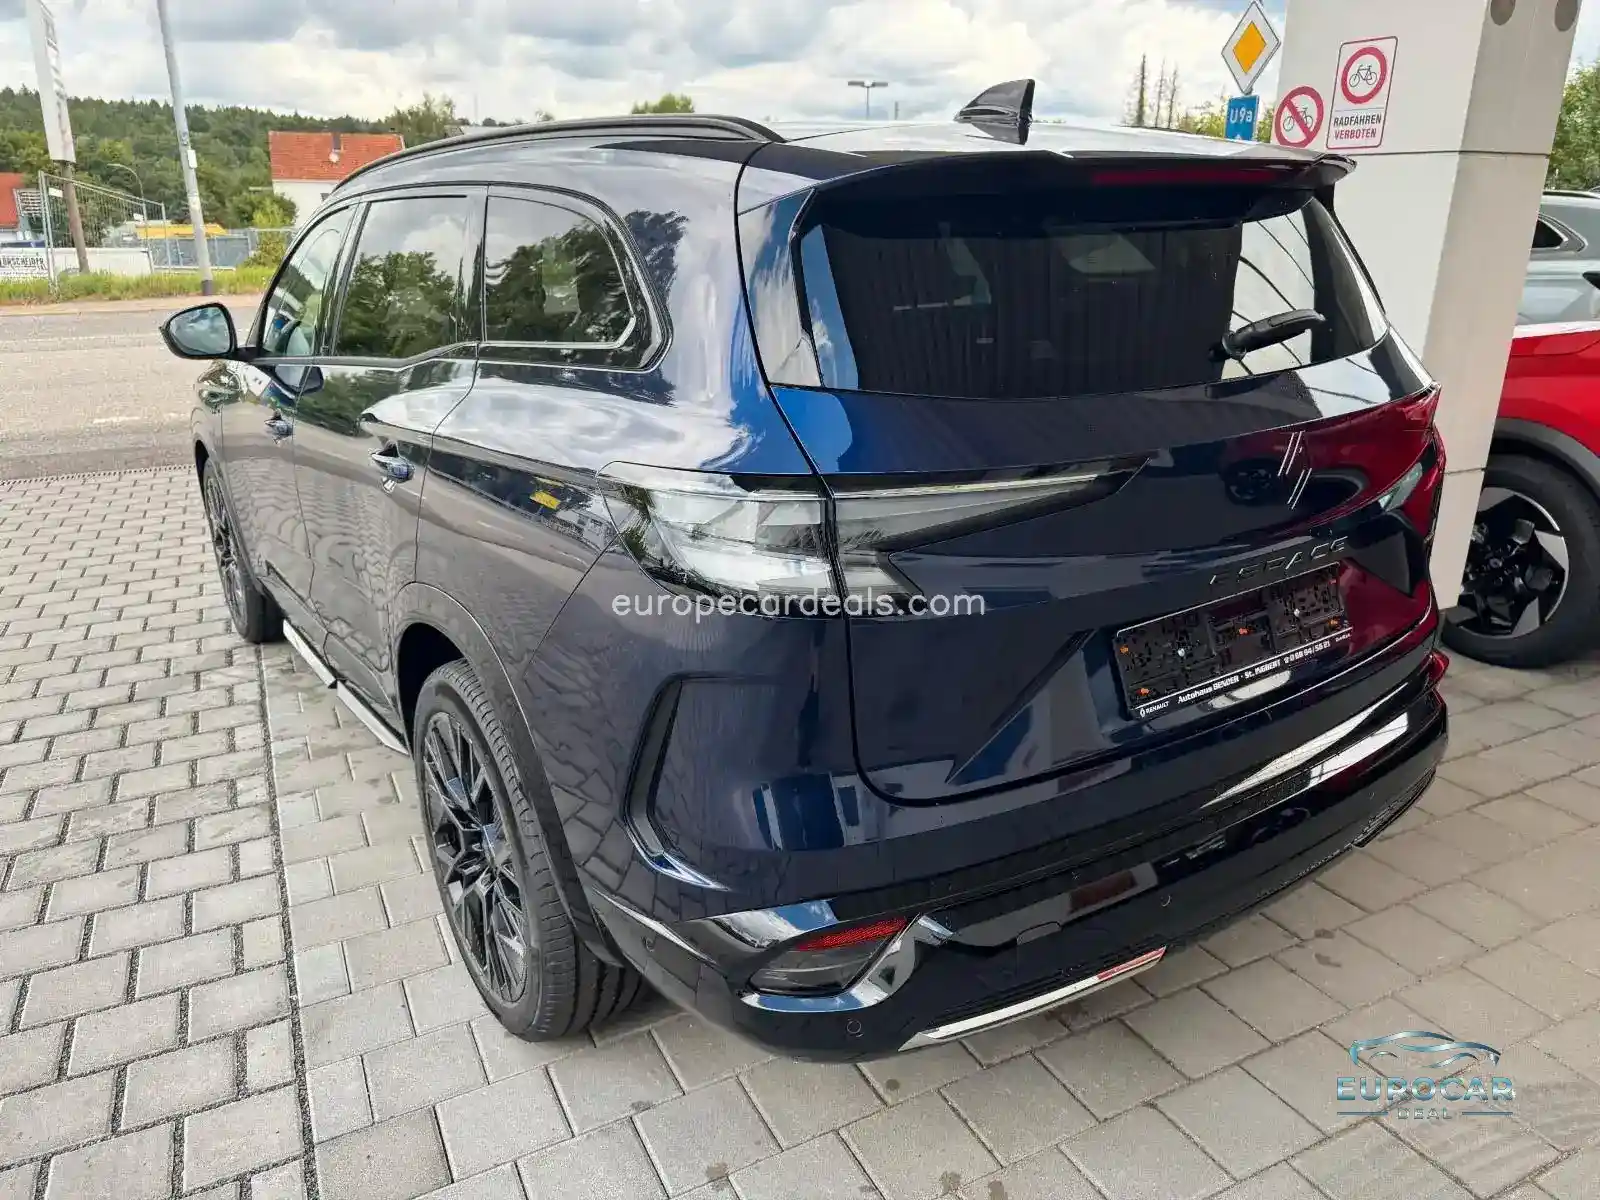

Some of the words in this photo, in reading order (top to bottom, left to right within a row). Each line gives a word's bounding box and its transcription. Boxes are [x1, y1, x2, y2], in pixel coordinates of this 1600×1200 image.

[1334, 114, 1381, 126] RADFAHREN
[1335, 128, 1377, 140] VERBOTEN
[1178, 686, 1212, 704] Autohaus
[1213, 675, 1239, 690] BENDER
[1145, 701, 1169, 714] RENAULT
